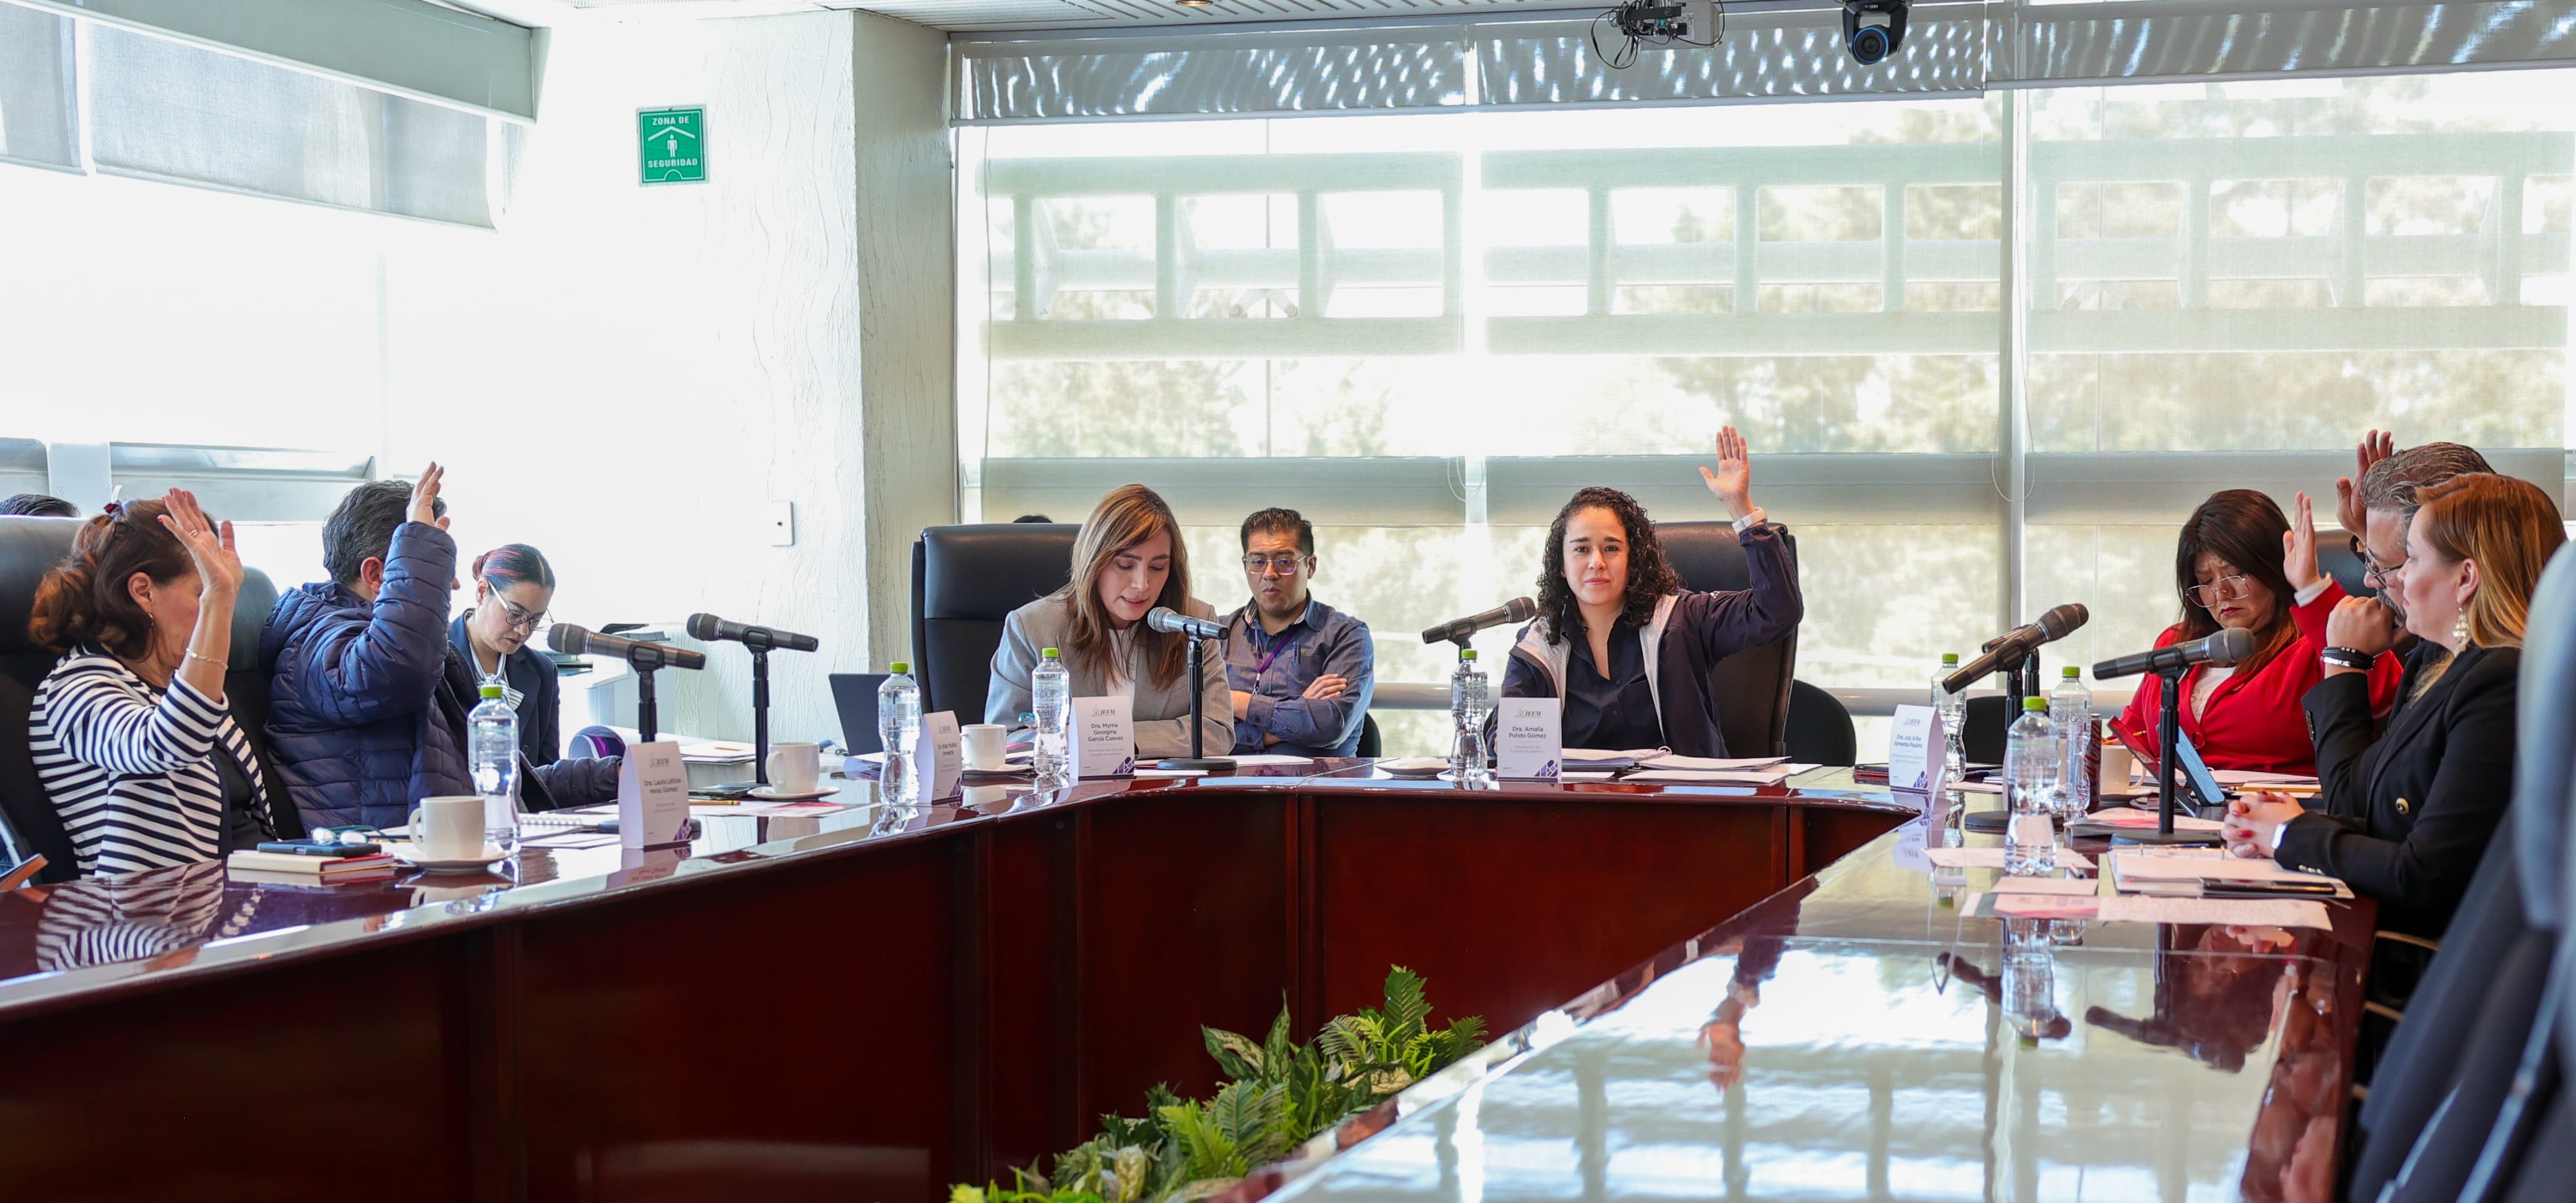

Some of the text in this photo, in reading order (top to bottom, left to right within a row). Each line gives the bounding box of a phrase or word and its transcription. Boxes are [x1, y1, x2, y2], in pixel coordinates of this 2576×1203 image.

[652, 116, 689, 126] ZONA DE
[648, 158, 698, 168] SEGURIDAD
